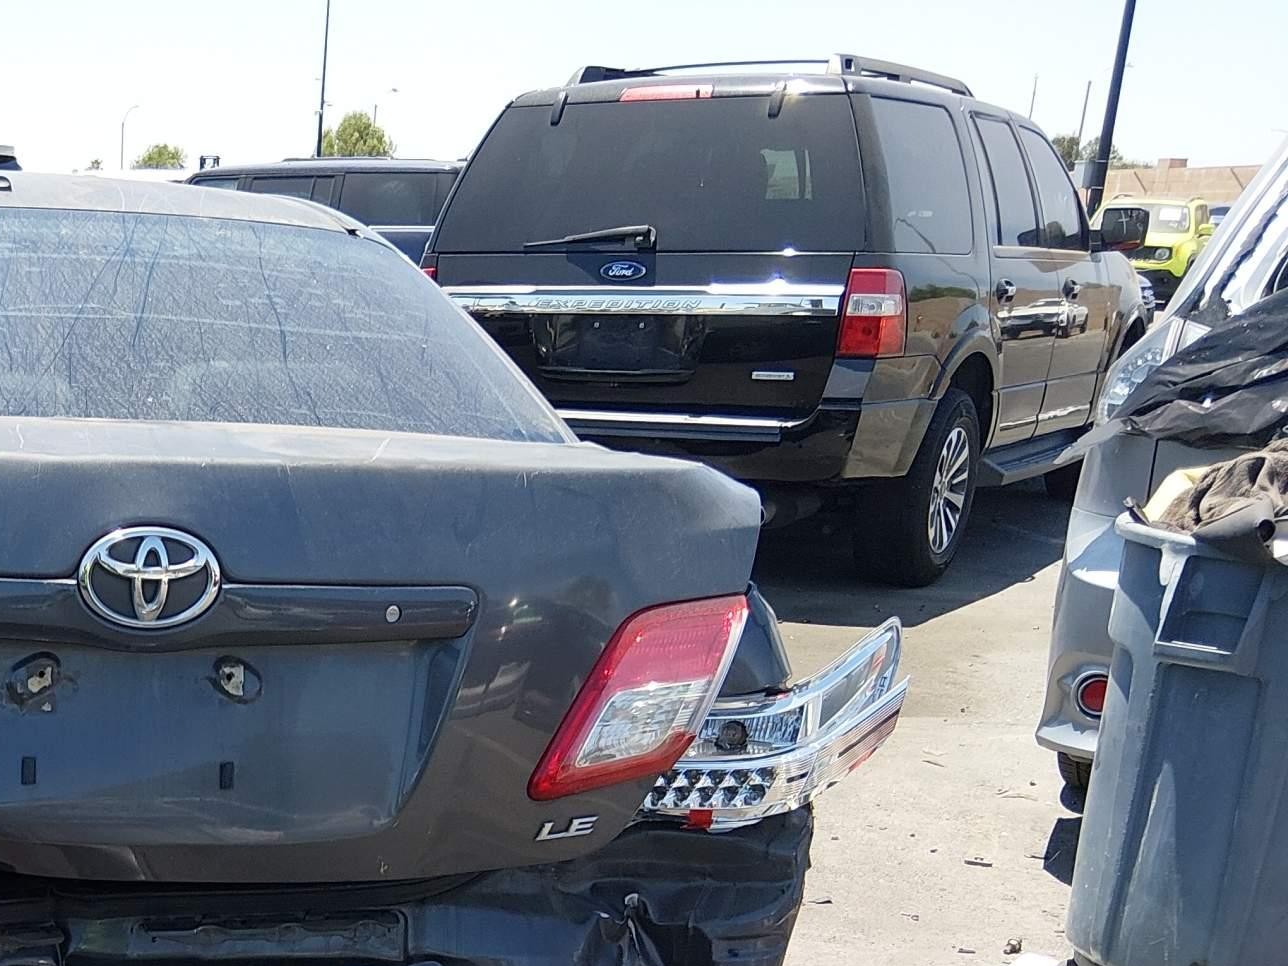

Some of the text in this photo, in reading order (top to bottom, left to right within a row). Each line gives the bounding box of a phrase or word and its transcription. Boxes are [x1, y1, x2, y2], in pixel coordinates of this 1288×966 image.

[608, 264, 635, 276] Ford
[535, 299, 702, 310] EXPEDITION
[535, 816, 600, 841] LE
